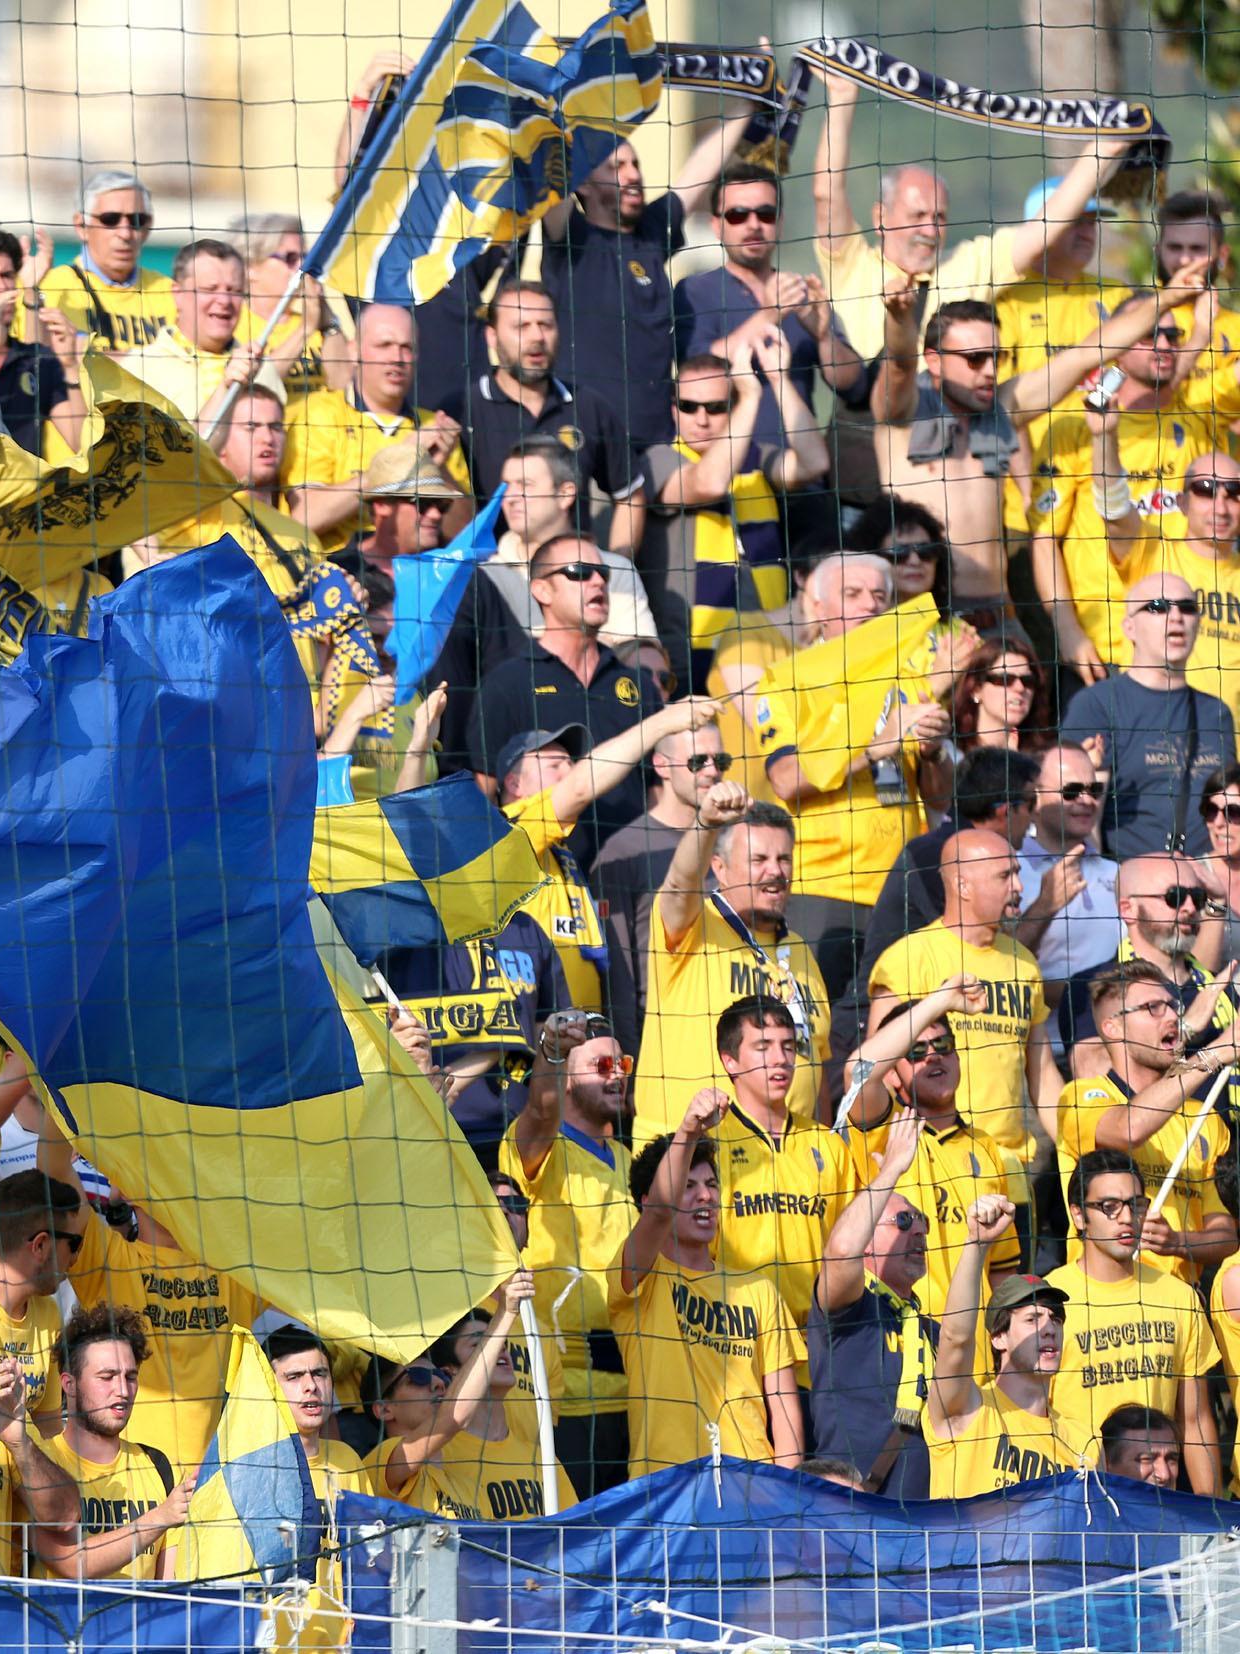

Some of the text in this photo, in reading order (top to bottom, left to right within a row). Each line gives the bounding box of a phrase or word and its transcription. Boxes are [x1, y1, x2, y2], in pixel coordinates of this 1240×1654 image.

[935, 77, 1130, 129] MODENA
[1075, 1320, 1176, 1355] VECCHIE
[1081, 1354, 1176, 1389] BRIGATE
